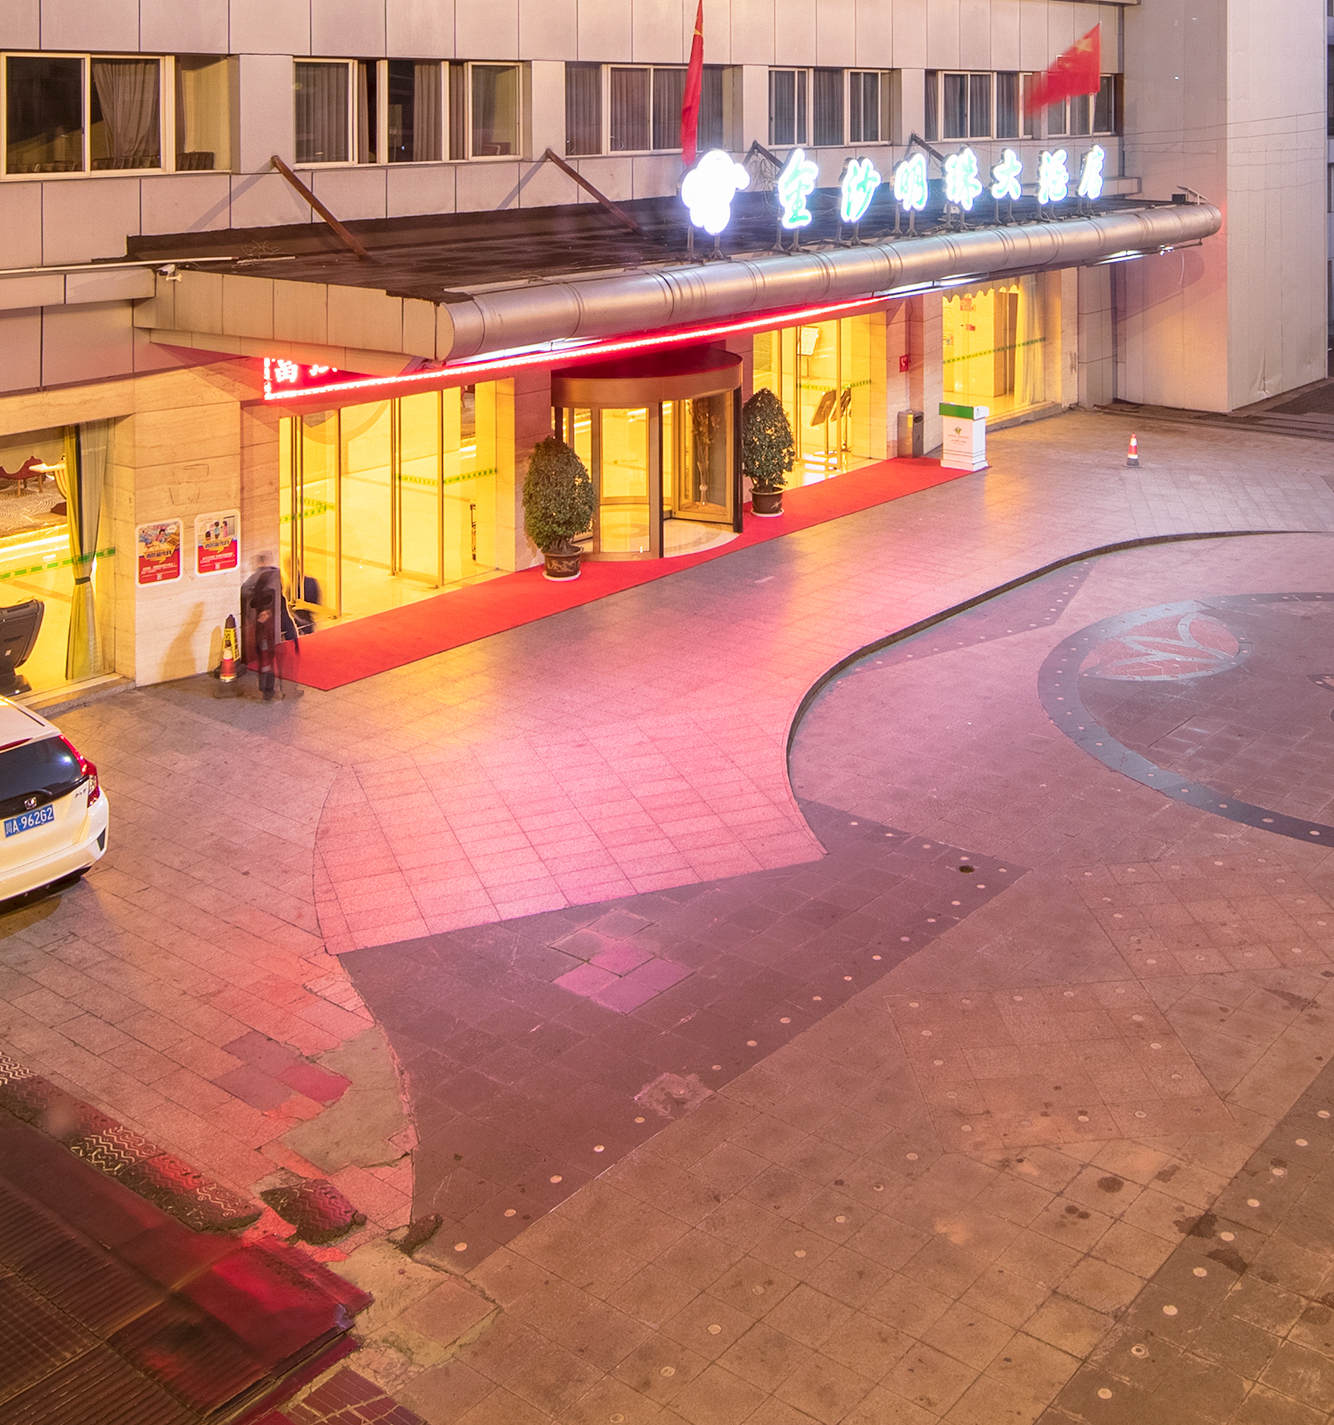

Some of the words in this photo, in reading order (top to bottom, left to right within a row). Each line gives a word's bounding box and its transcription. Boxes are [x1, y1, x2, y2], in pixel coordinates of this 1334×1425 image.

[778, 144, 1106, 229] 金沙明珠大酒店
